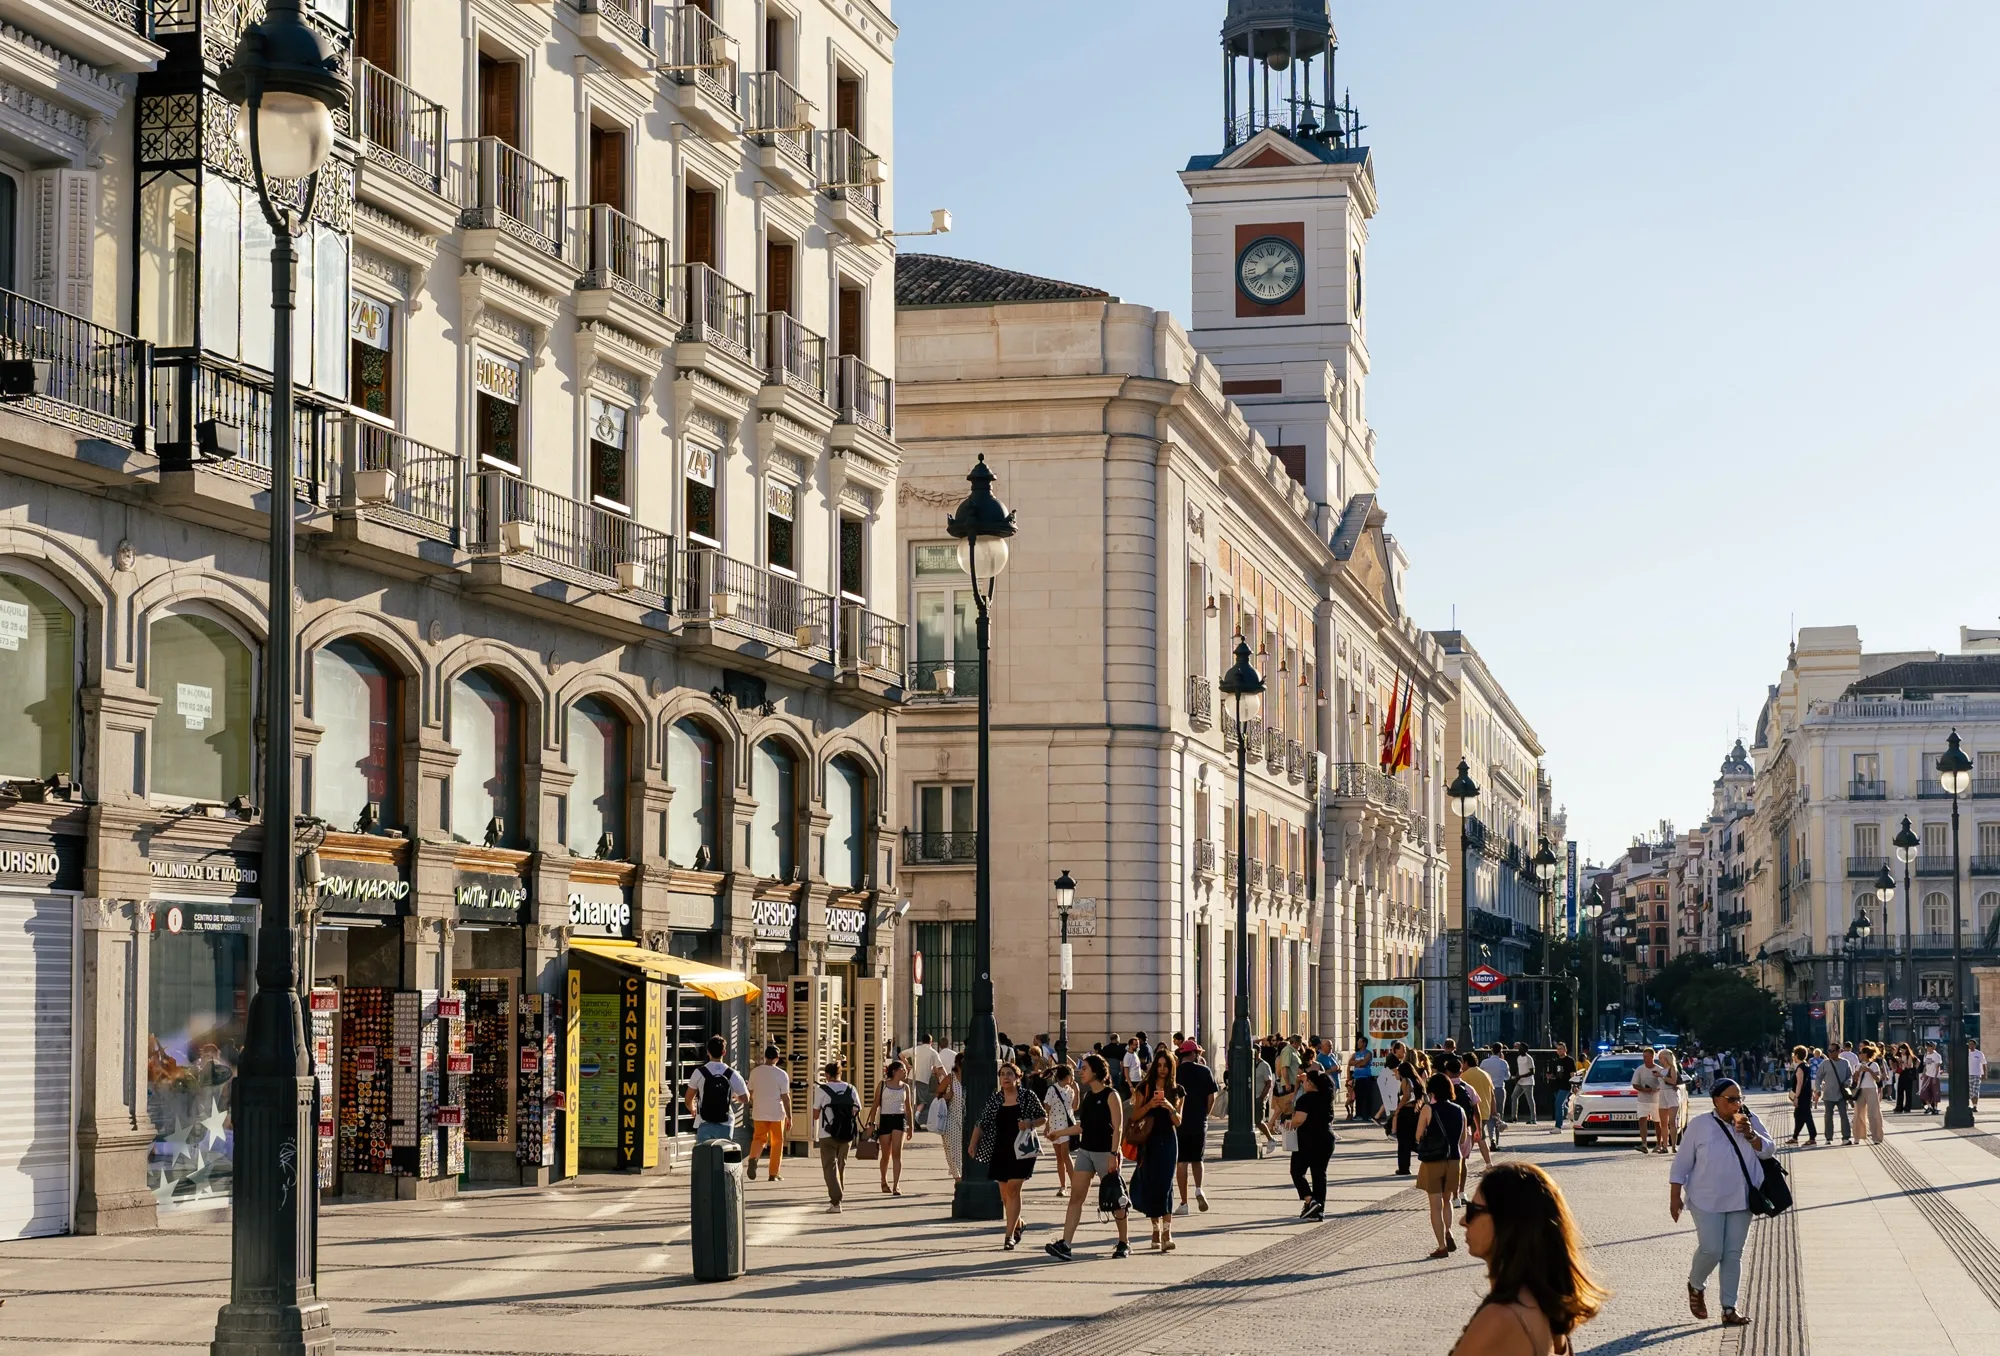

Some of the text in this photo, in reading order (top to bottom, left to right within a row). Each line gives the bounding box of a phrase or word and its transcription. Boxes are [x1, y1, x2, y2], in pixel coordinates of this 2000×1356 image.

[687, 444, 712, 480] ZAP
[0, 849, 60, 875] URISMO
[150, 860, 258, 884] OMUNIDAD DE MADRID
[355, 877, 410, 902] MADRID
[457, 884, 488, 908] WITH
[193, 913, 212, 922] CENTRO
[213, 914, 220, 922] DE
[220, 914, 240, 923] TURISMO
[240, 915, 247, 923] DE
[569, 893, 631, 933] Change
[751, 899, 797, 927] ZAPSHOP
[825, 907, 866, 933] ZAPSHOP
[193, 922, 241, 931] SOL TOURIST CENTER
[1061, 926, 1096, 935] ARRETAS
[625, 976, 638, 1073] CHANGE
[1369, 1009, 1409, 1019] BURGER
[1369, 1019, 1409, 1032] KING
[570, 976, 579, 1144] CHANGE
[648, 981, 658, 1136] CHANGE
[623, 1082, 638, 1161] MONEY
